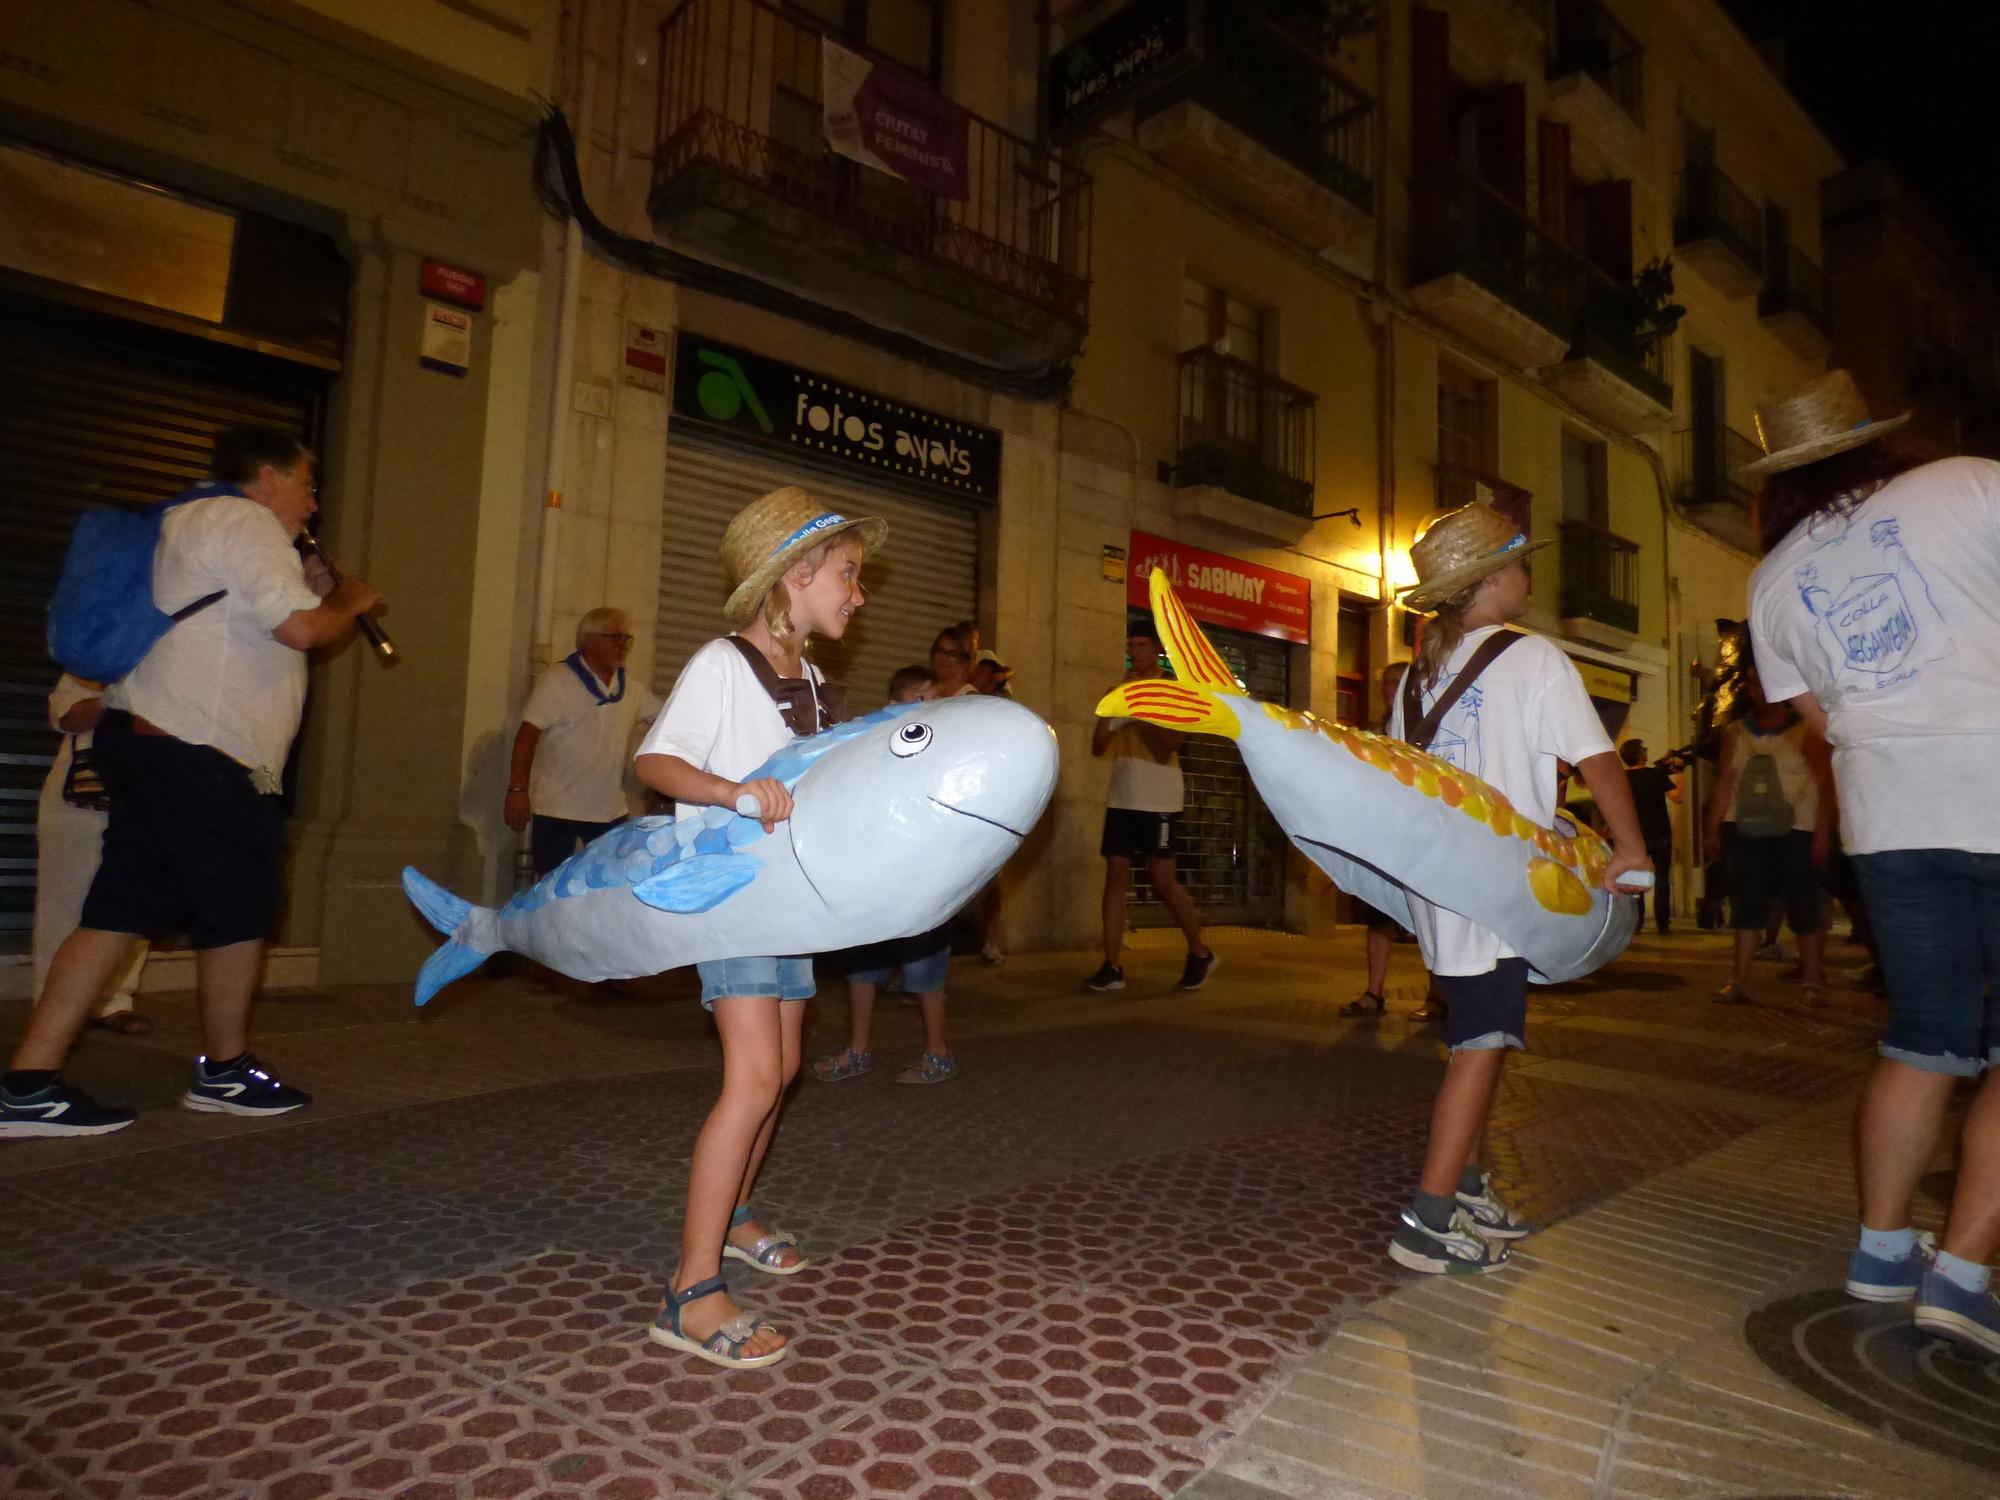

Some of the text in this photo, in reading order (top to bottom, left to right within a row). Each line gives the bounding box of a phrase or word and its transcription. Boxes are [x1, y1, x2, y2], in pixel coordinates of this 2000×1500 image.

[796, 392, 972, 477] fotos ayats
[1187, 562, 1266, 605] SABWAY
[1840, 592, 1889, 628] COLLA
